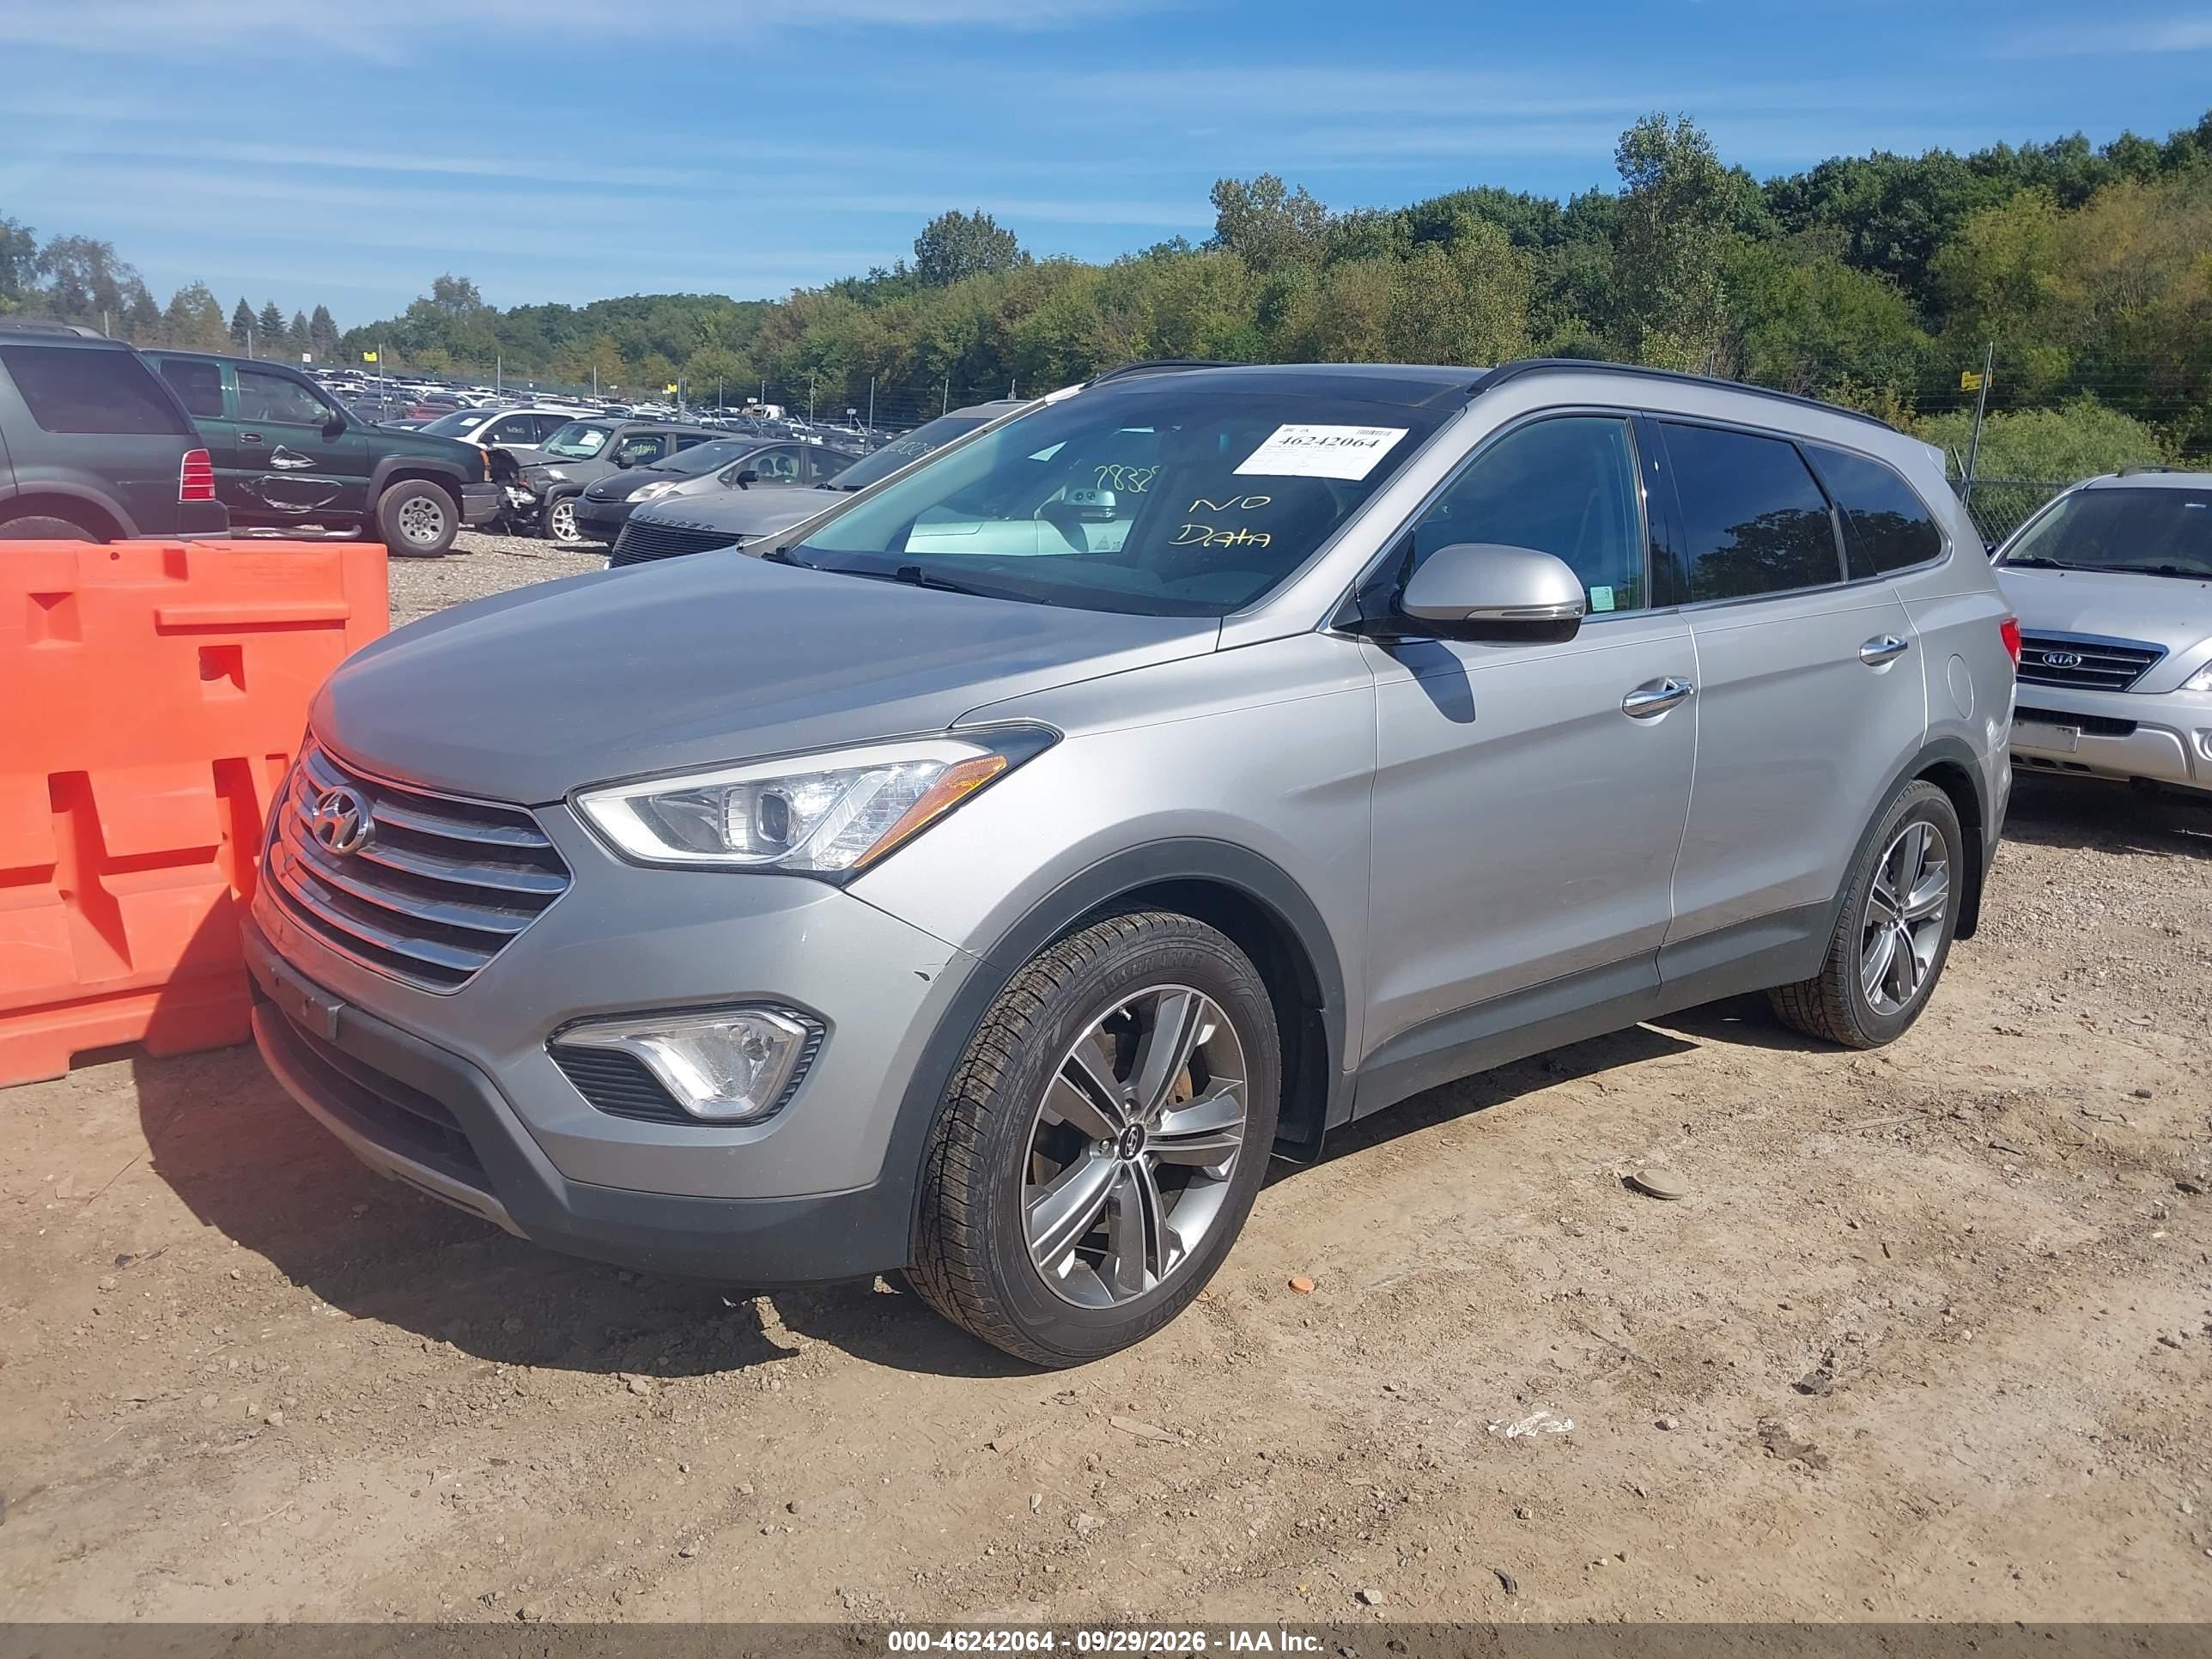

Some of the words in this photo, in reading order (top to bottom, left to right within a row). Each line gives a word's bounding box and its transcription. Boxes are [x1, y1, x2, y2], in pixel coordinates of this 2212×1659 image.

[1278, 435, 1381, 448] 46242064
[1188, 495, 1271, 513] NO
[2048, 653, 2074, 665] KIA
